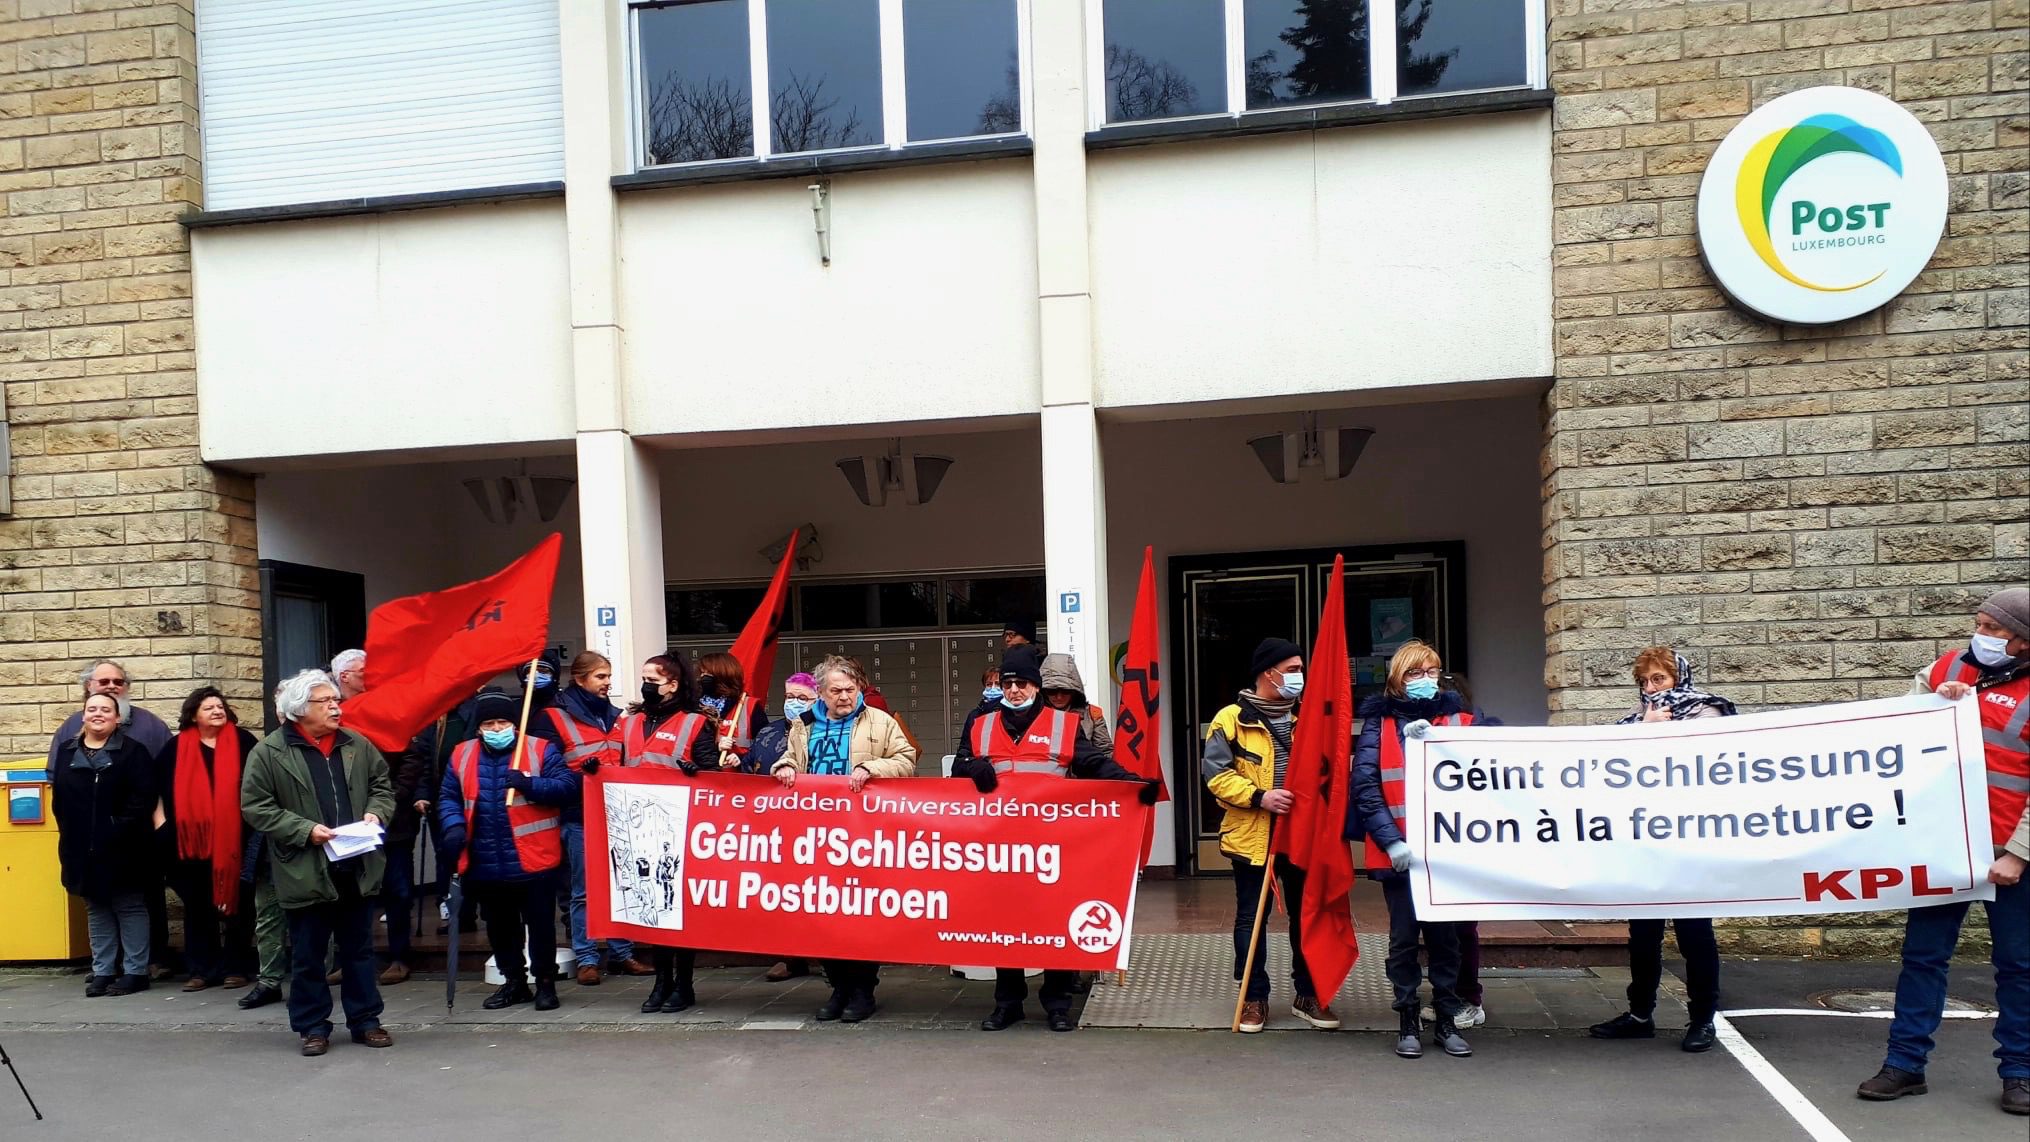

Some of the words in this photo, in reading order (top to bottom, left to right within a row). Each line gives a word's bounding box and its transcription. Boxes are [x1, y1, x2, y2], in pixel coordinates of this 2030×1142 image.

[1792, 234, 1886, 252] LUXEMBOURG
[602, 609, 614, 625] P
[1065, 594, 1078, 612] P
[1432, 758, 1545, 792] Géint
[1560, 743, 1904, 789] d’Schléissung
[694, 788, 725, 807] Fir
[731, 795, 746, 808] e
[753, 791, 852, 814] gudden
[863, 795, 1121, 822] Universaldéngscht
[1433, 811, 1521, 844] Non
[1536, 808, 1560, 843] à
[1575, 808, 1614, 842] la
[1628, 802, 1874, 840] fermeture
[690, 821, 783, 864] Géint
[792, 826, 1061, 884] d’Schléissung
[687, 876, 729, 908] vu
[737, 871, 949, 921] Postbüroen
[1803, 864, 1954, 902] KPL
[937, 931, 1067, 948] www.kp-l.org
[1077, 935, 1114, 947] KPL
